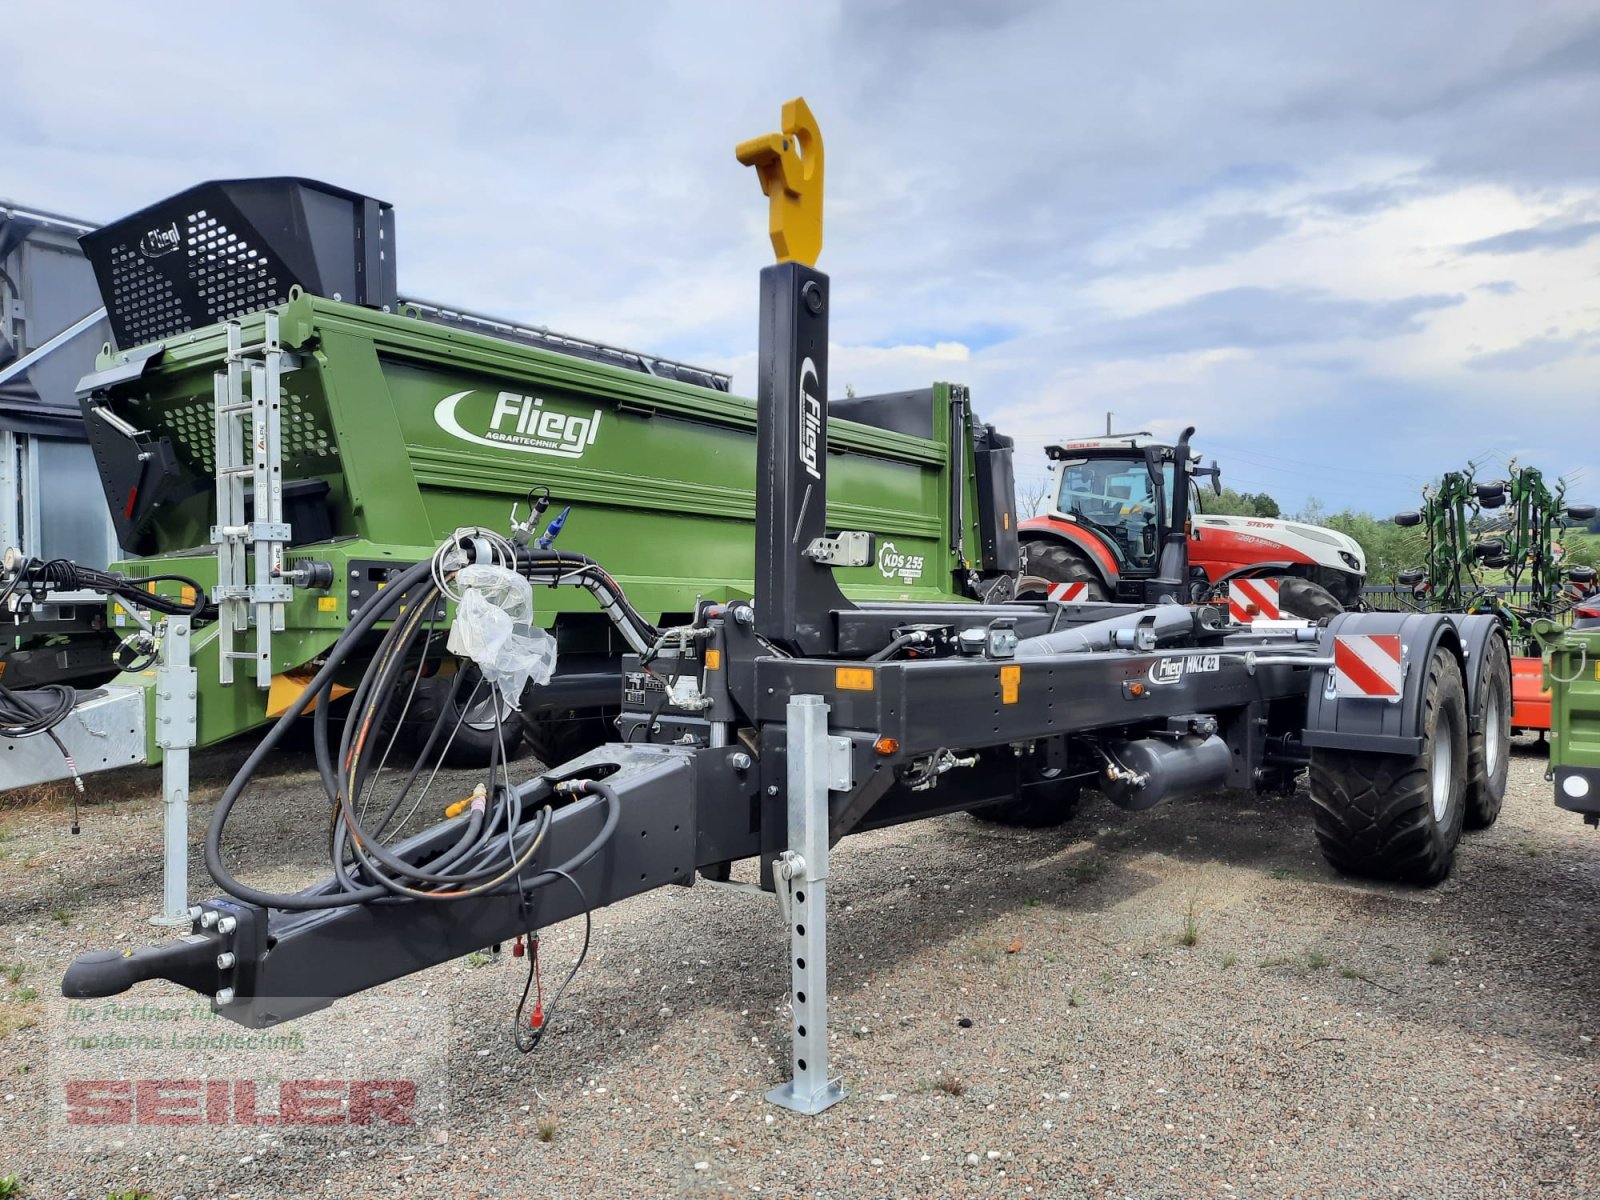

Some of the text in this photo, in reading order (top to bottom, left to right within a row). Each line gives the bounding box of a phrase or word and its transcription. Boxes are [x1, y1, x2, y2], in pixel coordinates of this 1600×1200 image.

[147, 222, 181, 249] Fliegl
[489, 391, 603, 453] Fliegl
[485, 431, 559, 449] AGRARTECHNIK
[802, 393, 821, 480] Fliegl
[1246, 521, 1275, 530] STEYR
[884, 553, 924, 569] KDS 255
[1159, 655, 1216, 679] Fliegl HKL 22
